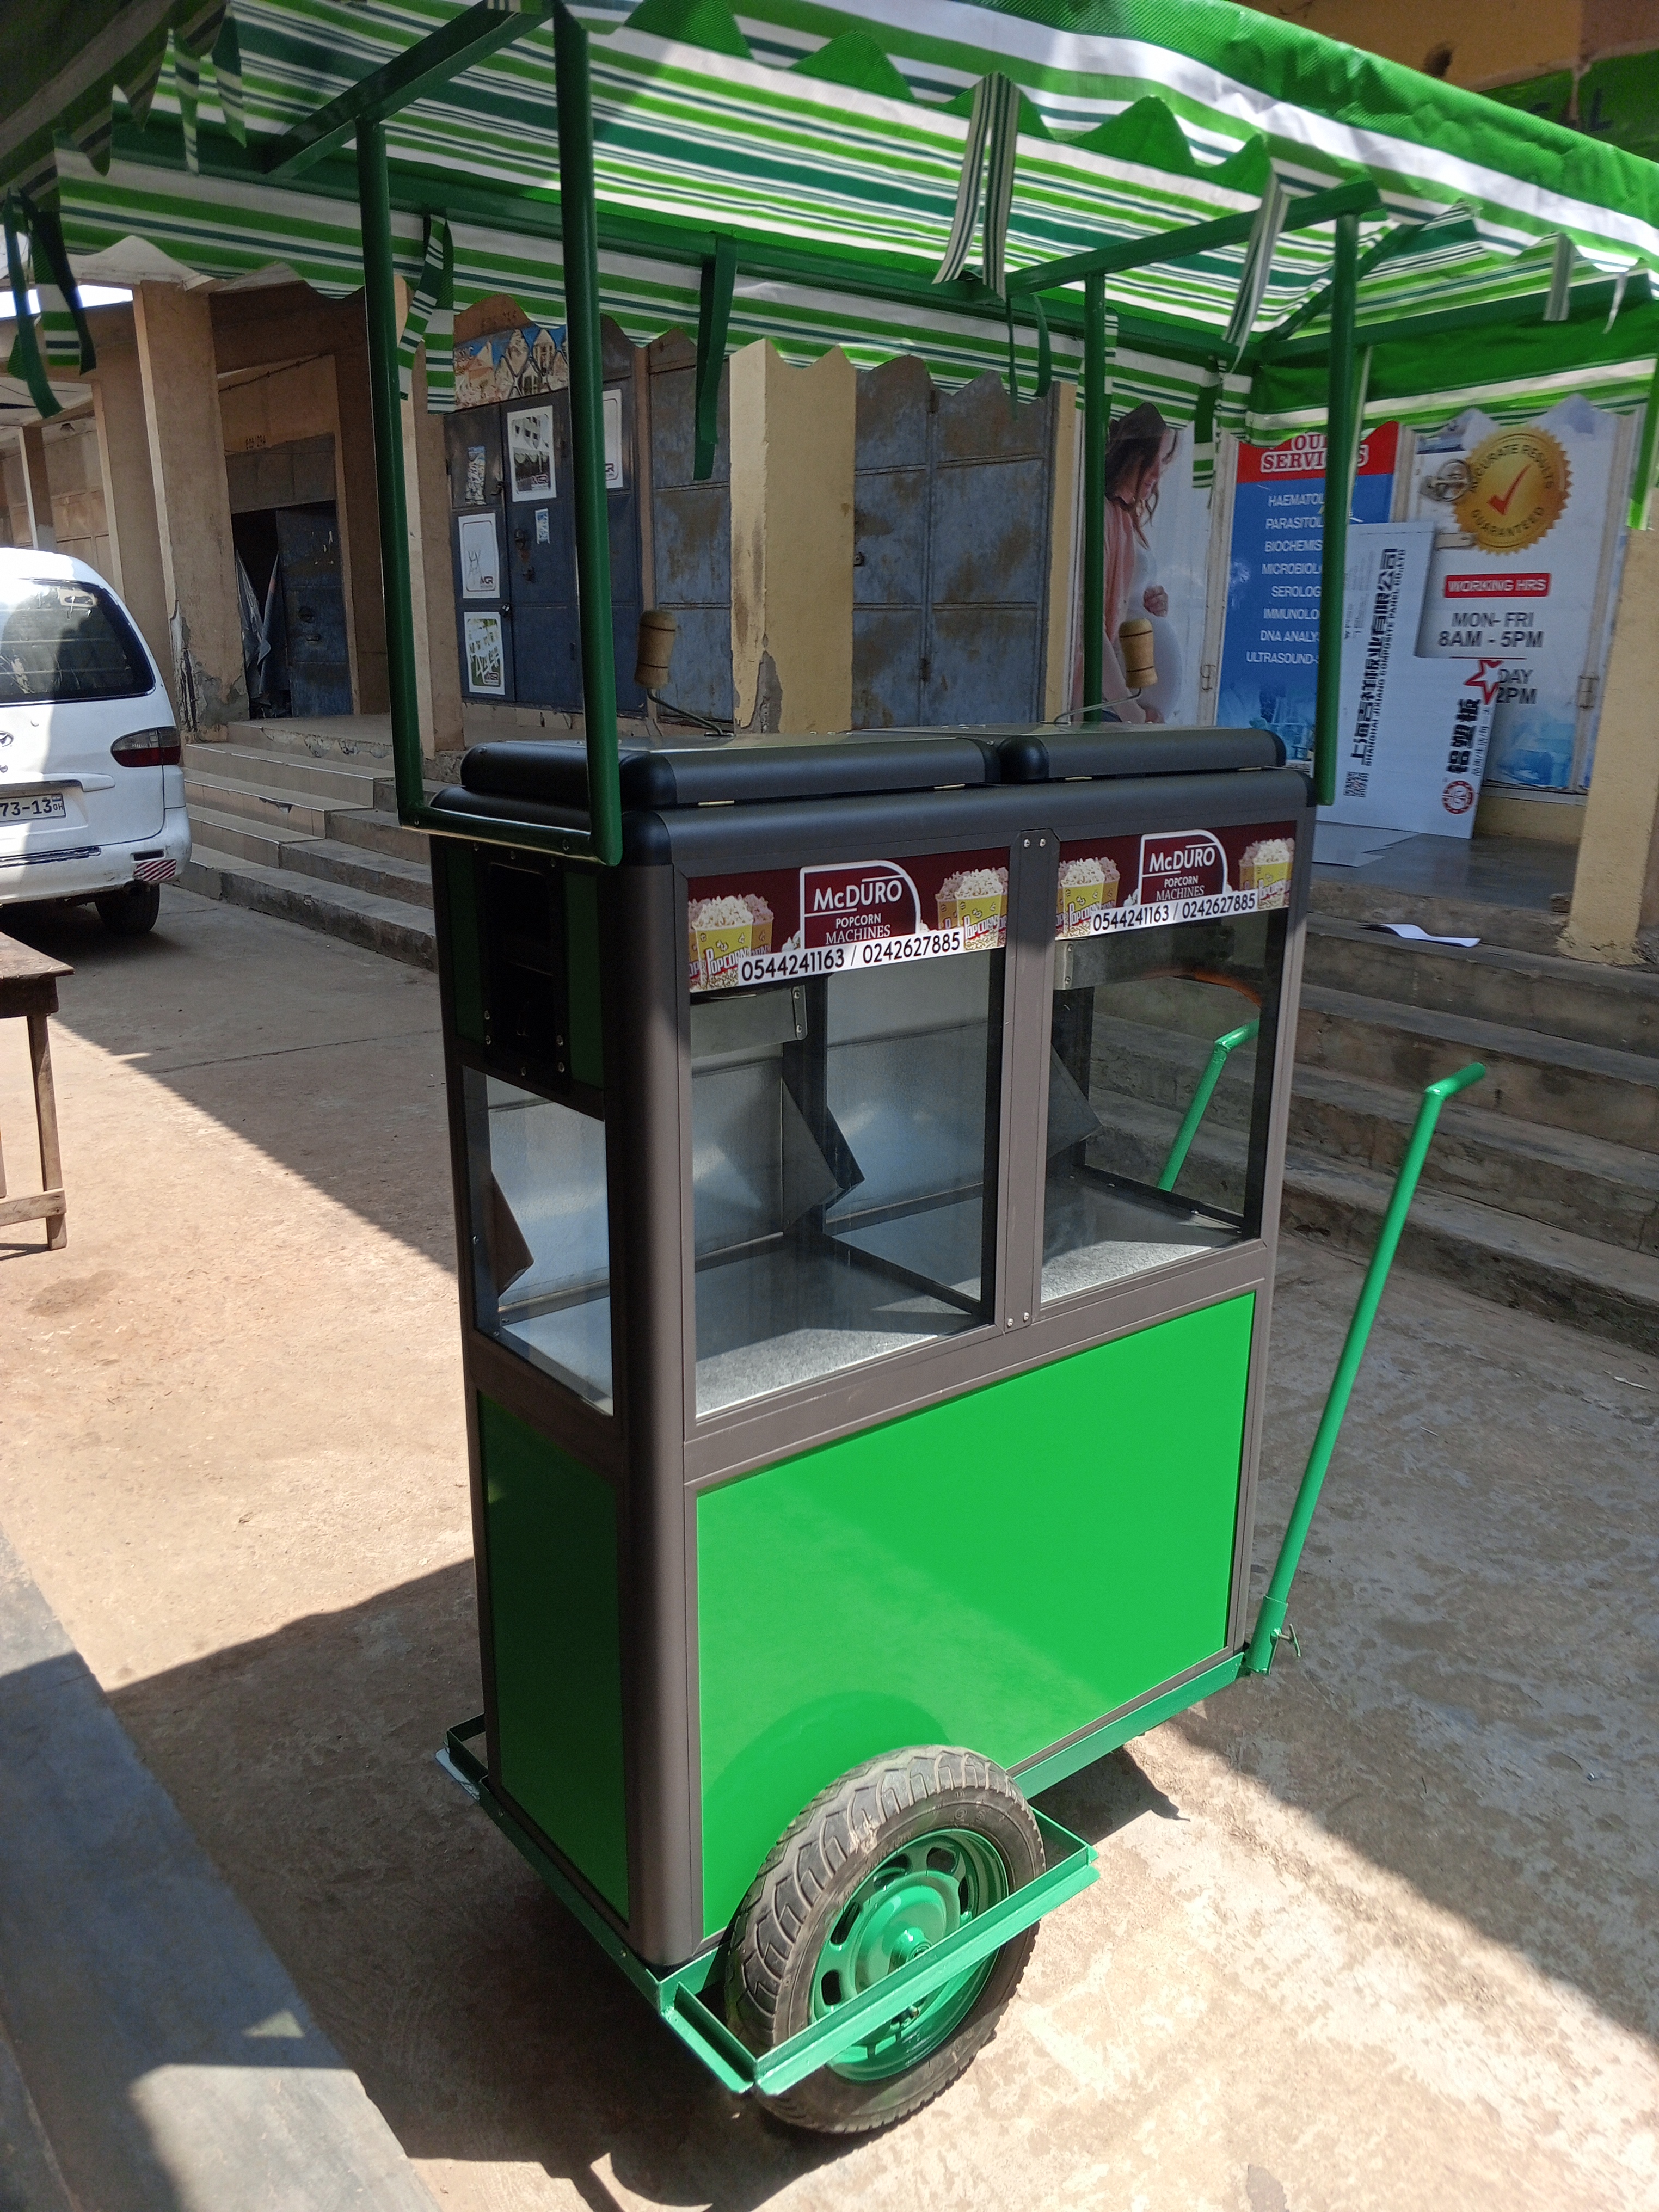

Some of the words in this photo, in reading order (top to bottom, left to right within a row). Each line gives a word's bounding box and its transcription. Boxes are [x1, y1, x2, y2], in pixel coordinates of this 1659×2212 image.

[1263, 447, 1366, 470] SERVIS
[1471, 506, 1545, 537] GUARANTEED
[1265, 539, 1323, 552] BIOCHEMIS
[1262, 562, 1322, 575] MICROBIOL
[1449, 580, 1513, 592] WORKING
[1516, 579, 1546, 591] HRS
[1452, 612, 1501, 628] MON-
[1504, 612, 1533, 627] FRI
[1260, 630, 1281, 643] DNA
[1283, 629, 1319, 642] ANALY
[1438, 631, 1482, 647] 8AM
[1501, 631, 1544, 647] 5PM
[0, 799, 53, 817] 73-13
[1148, 847, 1215, 873] McDURO
[1164, 875, 1199, 888] POPCORN
[813, 880, 902, 912] McDURO
[1156, 885, 1205, 901] MACHINES
[1093, 905, 1169, 931] 0544241163
[1173, 903, 1178, 920] /
[1182, 893, 1255, 918] 0242627885
[835, 913, 882, 928] POPCORN
[825, 925, 890, 945] MACHINES
[742, 949, 845, 981] 0544241163
[851, 945, 857, 967] /
[862, 931, 961, 964] 0242627885
